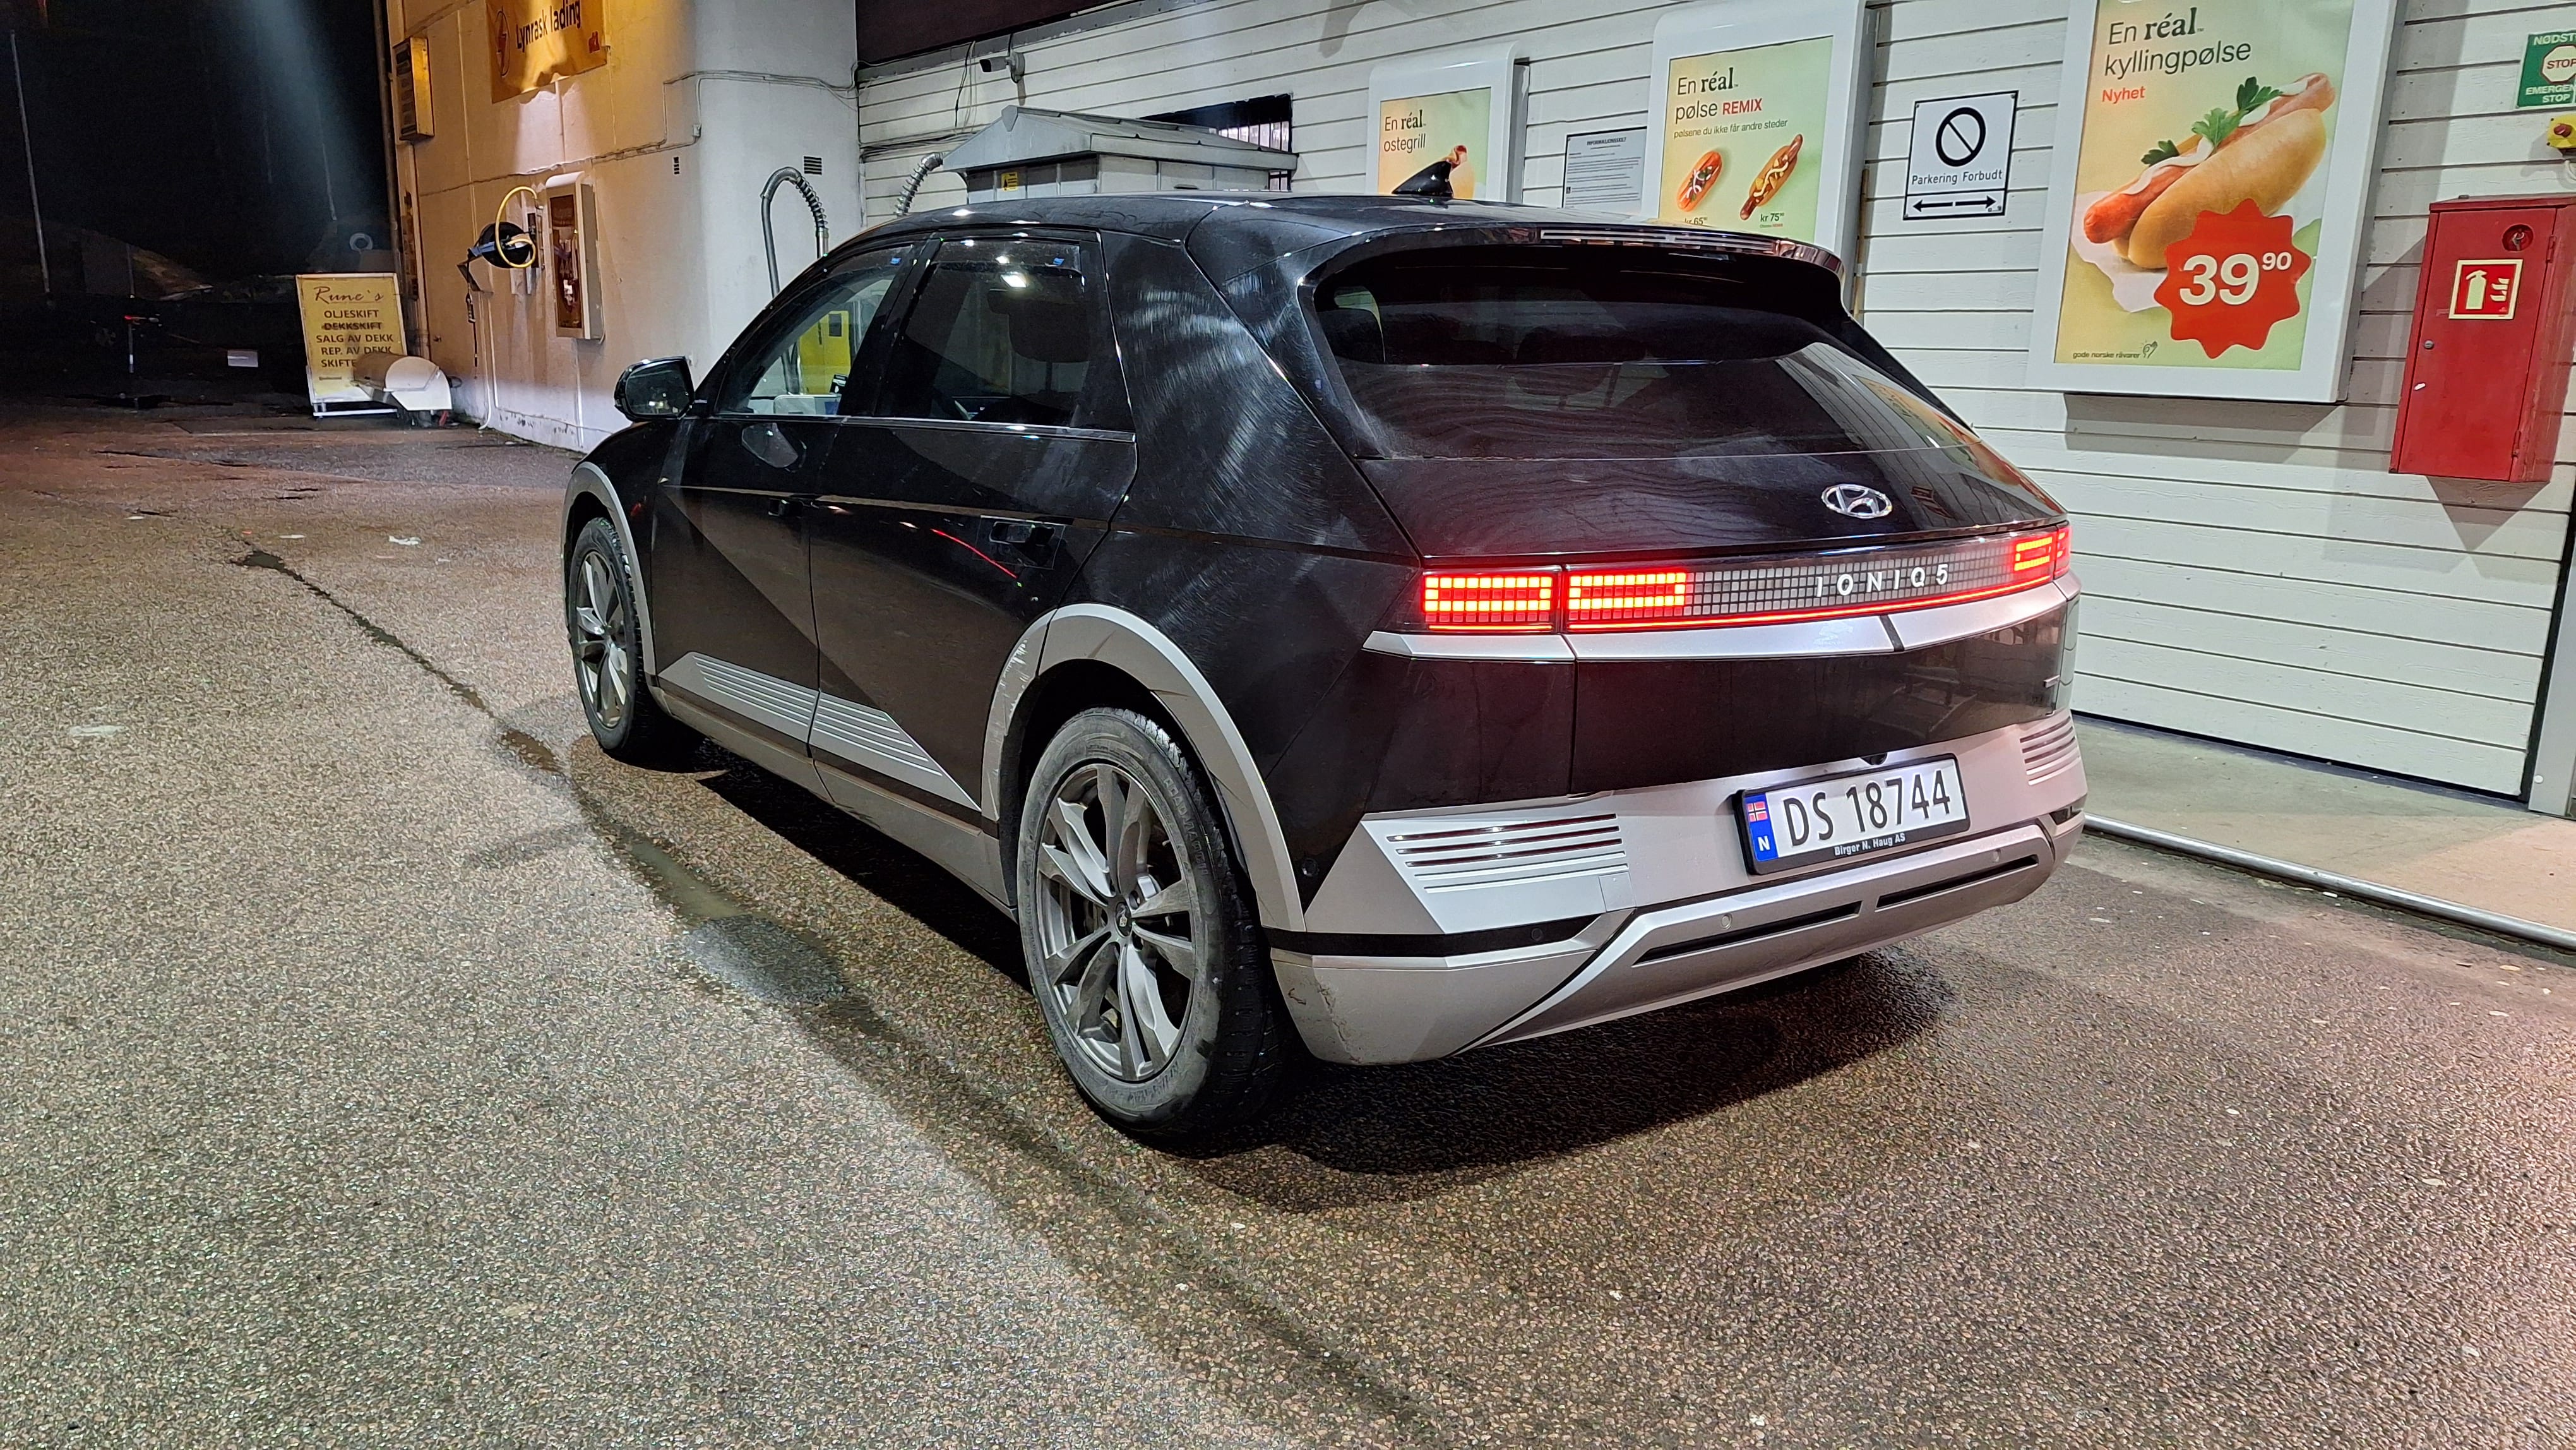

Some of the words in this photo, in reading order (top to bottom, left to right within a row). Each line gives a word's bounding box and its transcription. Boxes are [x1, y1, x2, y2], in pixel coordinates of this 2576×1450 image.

[516, 9, 548, 52] Lynrask
[550, 0, 581, 32] lading
[2109, 21, 2137, 45] En
[2144, 7, 2197, 40] réal
[2534, 33, 2576, 45] NØDST
[2104, 40, 2251, 80] kyllingpølse
[2547, 58, 2576, 69] STOP
[1677, 76, 1696, 95] En
[1700, 67, 1734, 92] réal
[2102, 86, 2146, 104] Nyhet
[2543, 94, 2571, 103] STOP
[1675, 100, 1718, 124] pølse
[1722, 98, 1763, 115] REMIX
[1385, 116, 1398, 131] En
[1674, 129, 1702, 139] pølsene
[1703, 127, 1712, 135] du
[1714, 126, 1728, 134] ikke
[1730, 124, 1740, 133] får
[1741, 121, 1762, 131] andre
[1763, 119, 1788, 129] steder
[1383, 133, 1426, 153] ostegrill
[1912, 172, 1957, 185] Parkering
[1962, 169, 2003, 182] Forbudt
[1760, 213, 1768, 222] kr
[2179, 253, 2260, 306] 39
[2262, 251, 2293, 271] 90
[324, 309, 379, 318] OLJESKIFT
[316, 335, 344, 343] SALG
[365, 334, 394, 342] DEKK
[321, 347, 343, 356] REP.
[1816, 567, 1927, 597] IONIQ
[1936, 563, 1949, 585] 5
[1782, 791, 1835, 847] DS
[1846, 769, 1951, 834] 18744
[1757, 836, 1771, 851] N
[1834, 844, 1860, 856] Birger
[1862, 841, 1871, 850] N.
[1873, 837, 1893, 848] Haug
[1895, 832, 1905, 843] AS
